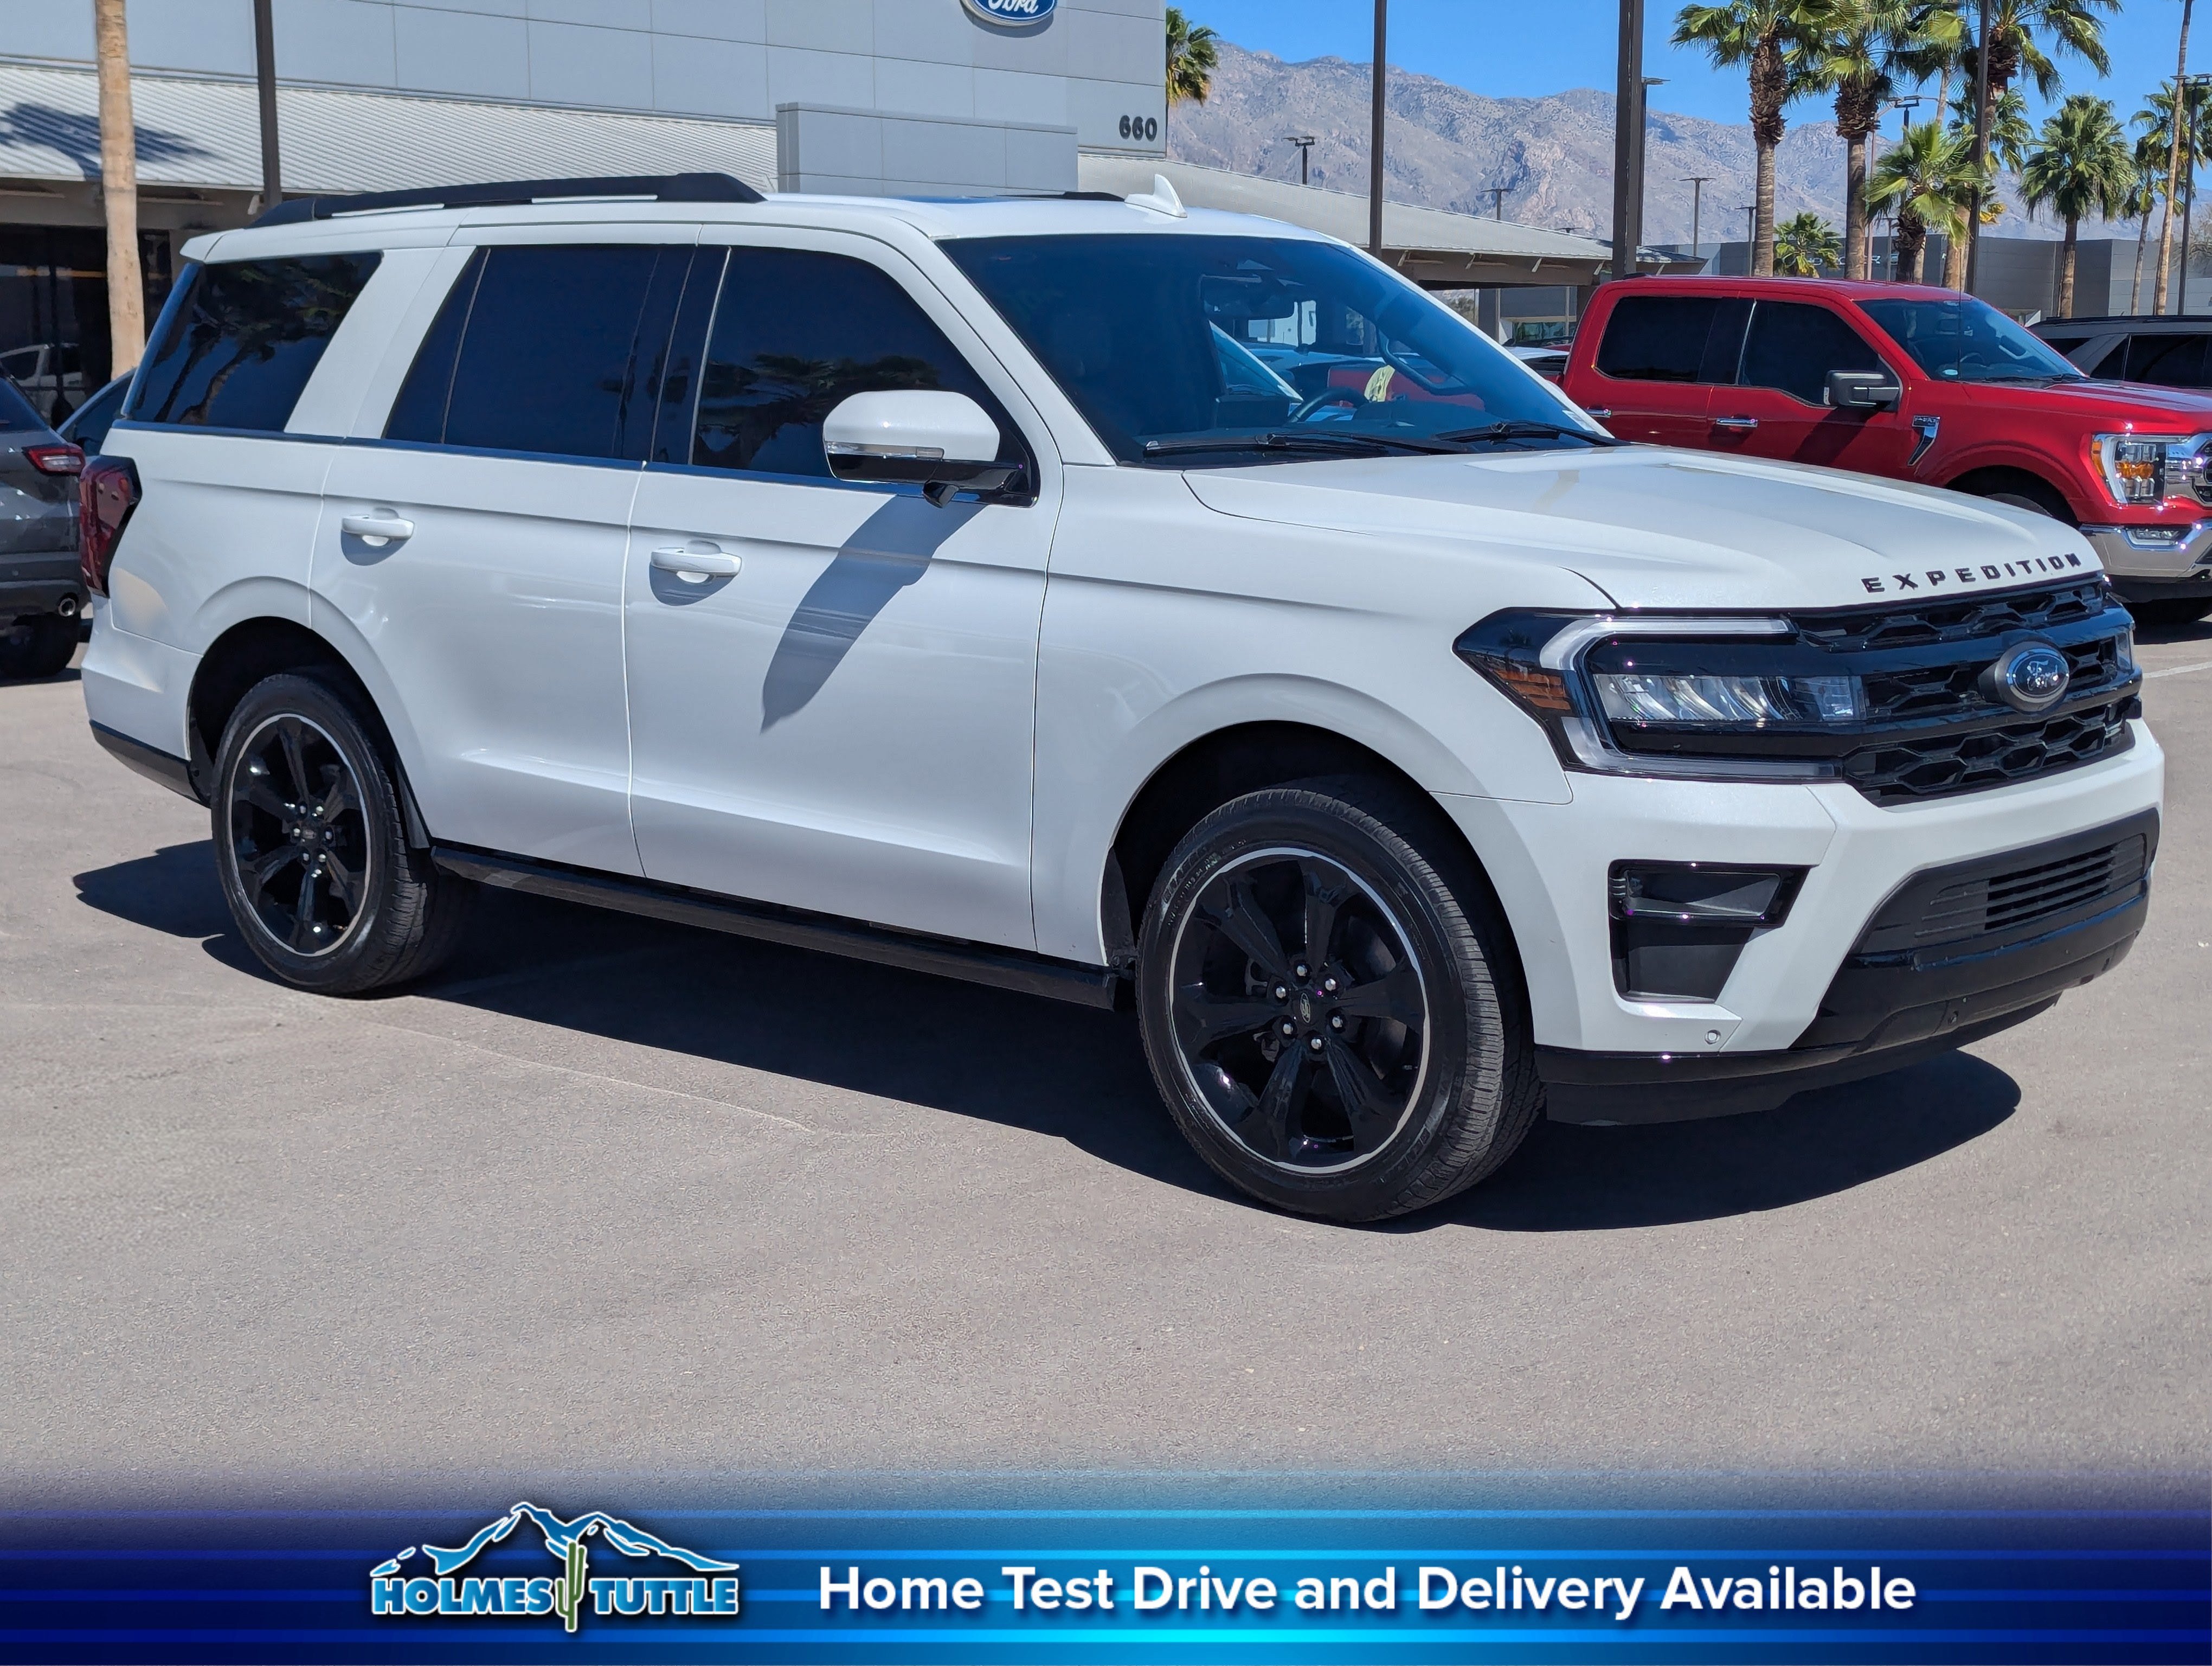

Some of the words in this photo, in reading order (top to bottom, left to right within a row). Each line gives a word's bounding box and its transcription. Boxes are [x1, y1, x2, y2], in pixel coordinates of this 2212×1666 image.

[1119, 115, 1158, 142] 660
[1861, 553, 2082, 593] EXPEDITION
[2026, 659, 2059, 691] Ford
